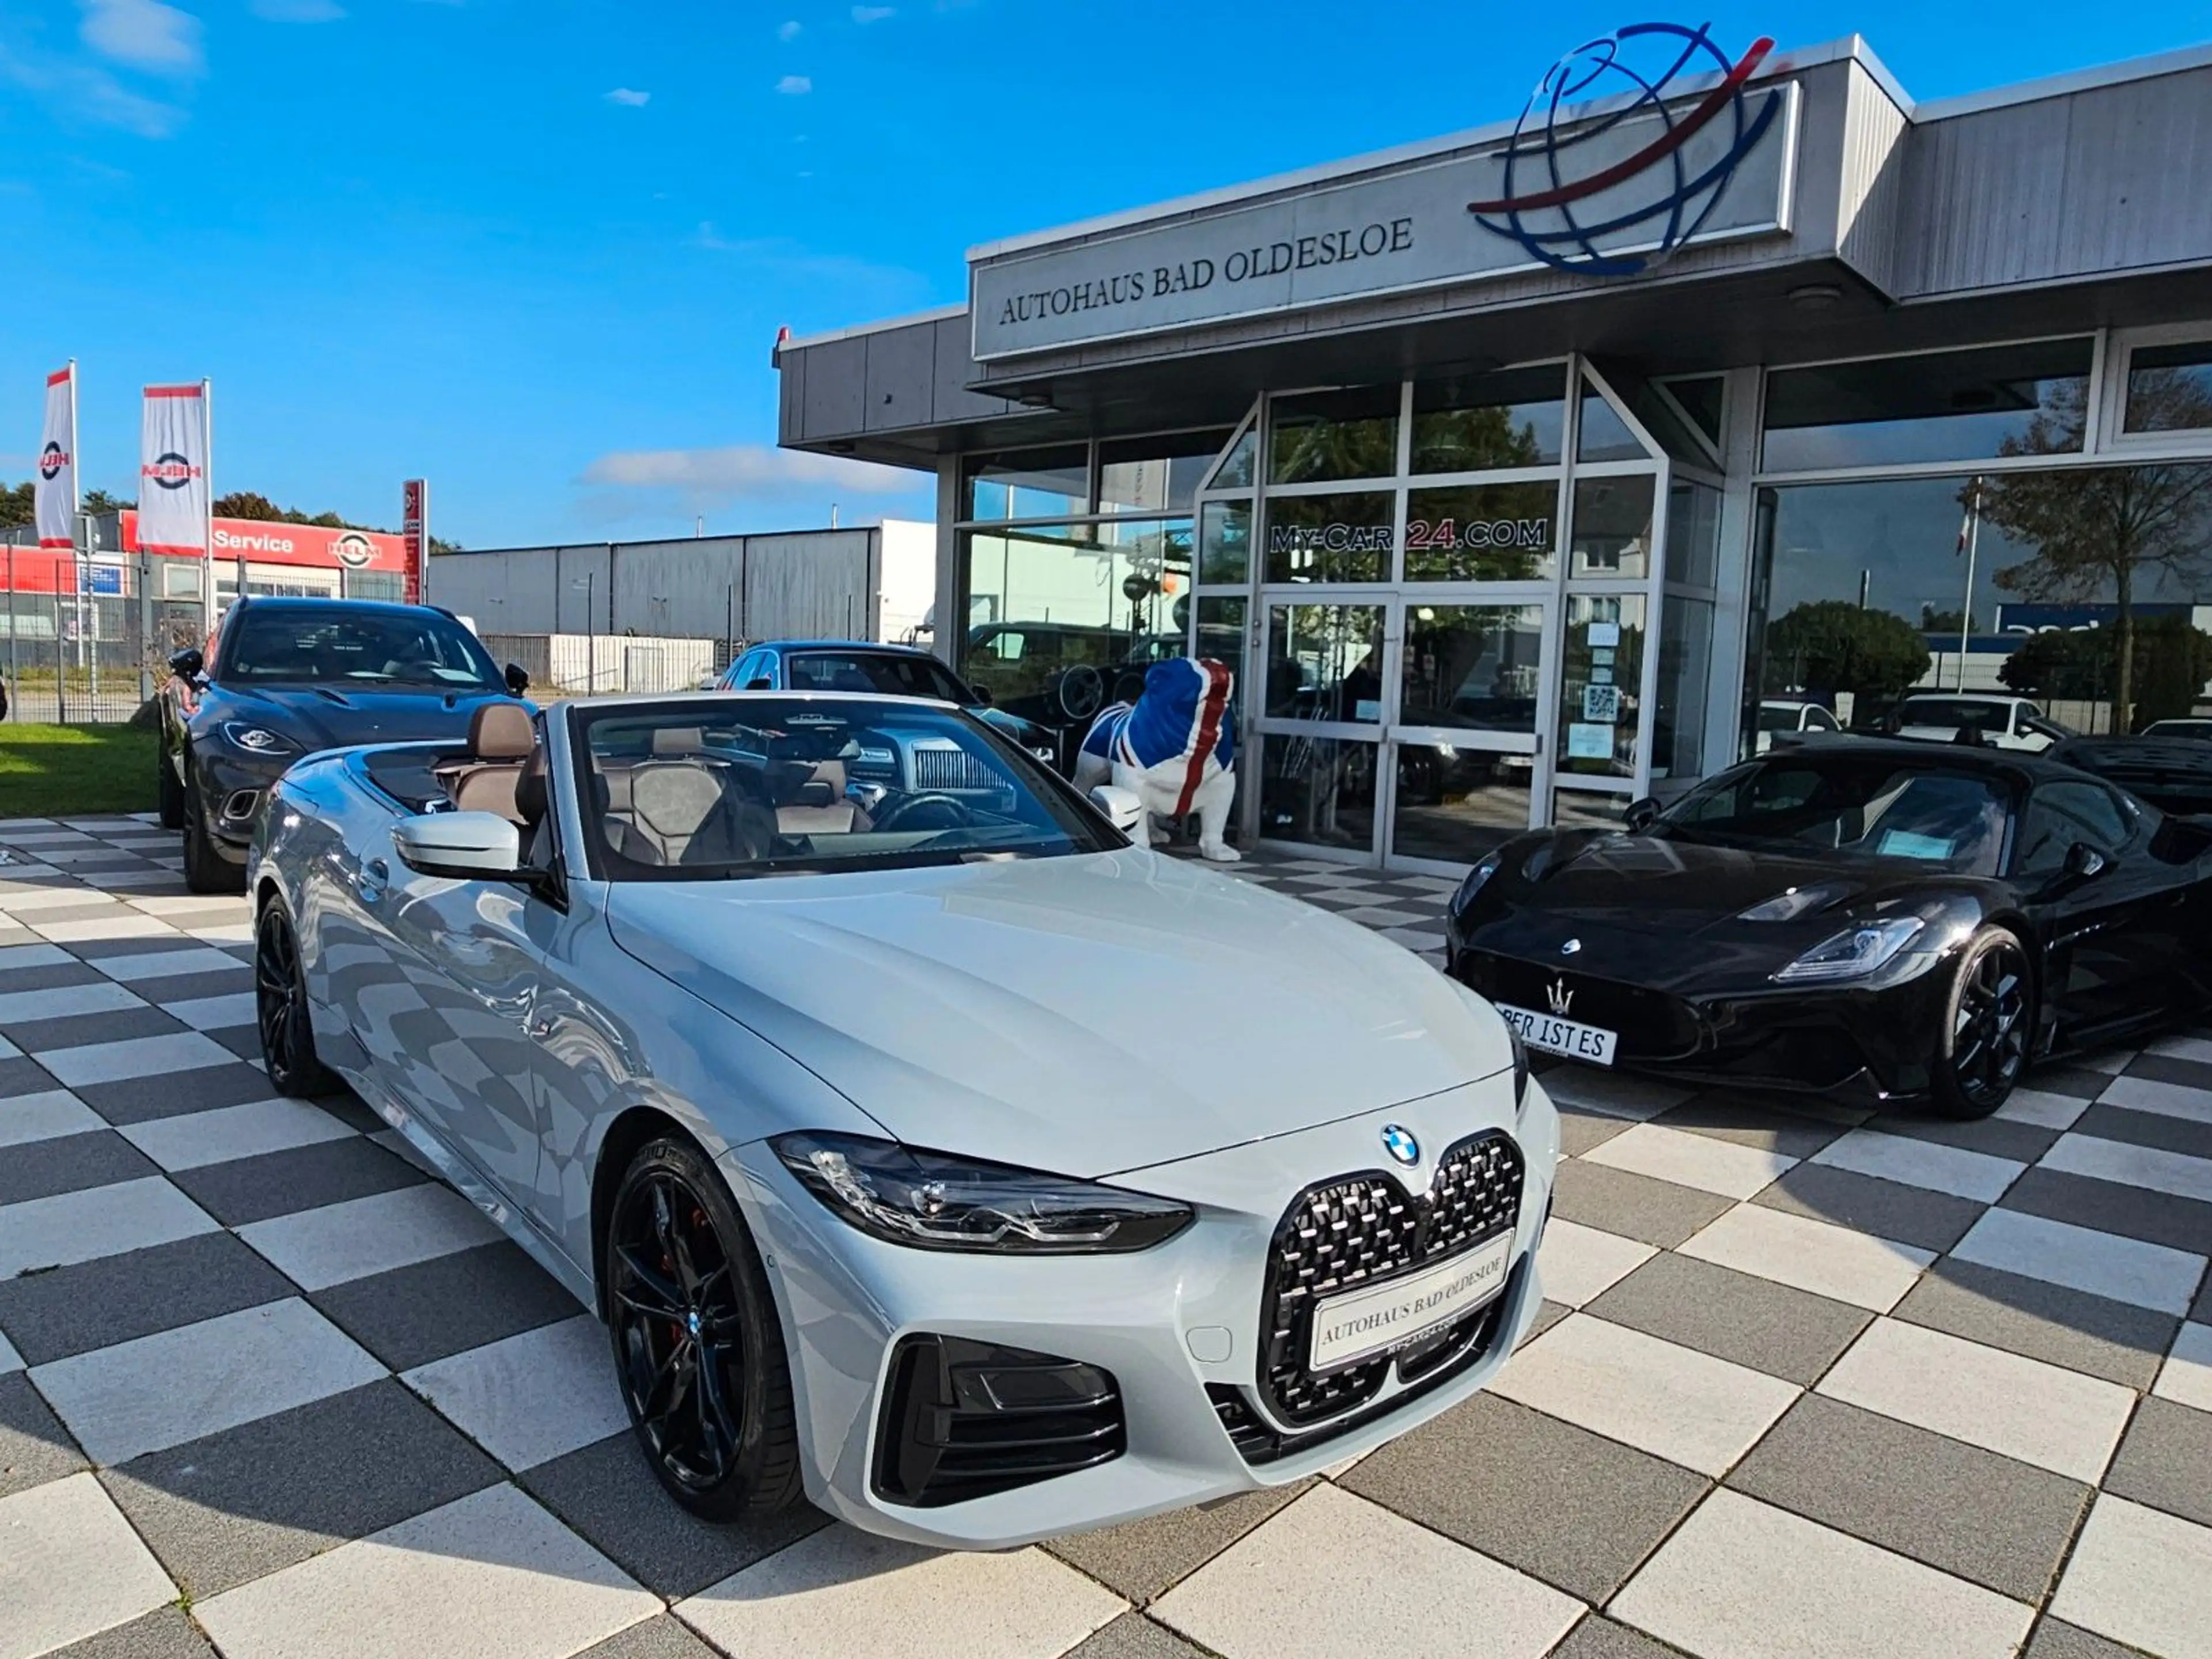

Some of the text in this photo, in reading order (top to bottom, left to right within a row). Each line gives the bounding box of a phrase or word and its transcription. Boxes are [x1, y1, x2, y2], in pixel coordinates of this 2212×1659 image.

[999, 217, 1413, 325] AUTOHAUS BAD OLDESLOE
[214, 530, 293, 554] Service
[1539, 1020, 1575, 1048] IST
[1579, 1030, 1604, 1056] ES
[1323, 1304, 1410, 1344] AUTOHAUS
[1414, 1289, 1443, 1313] BAD
[1446, 1257, 1501, 1300] OLDESLOE
